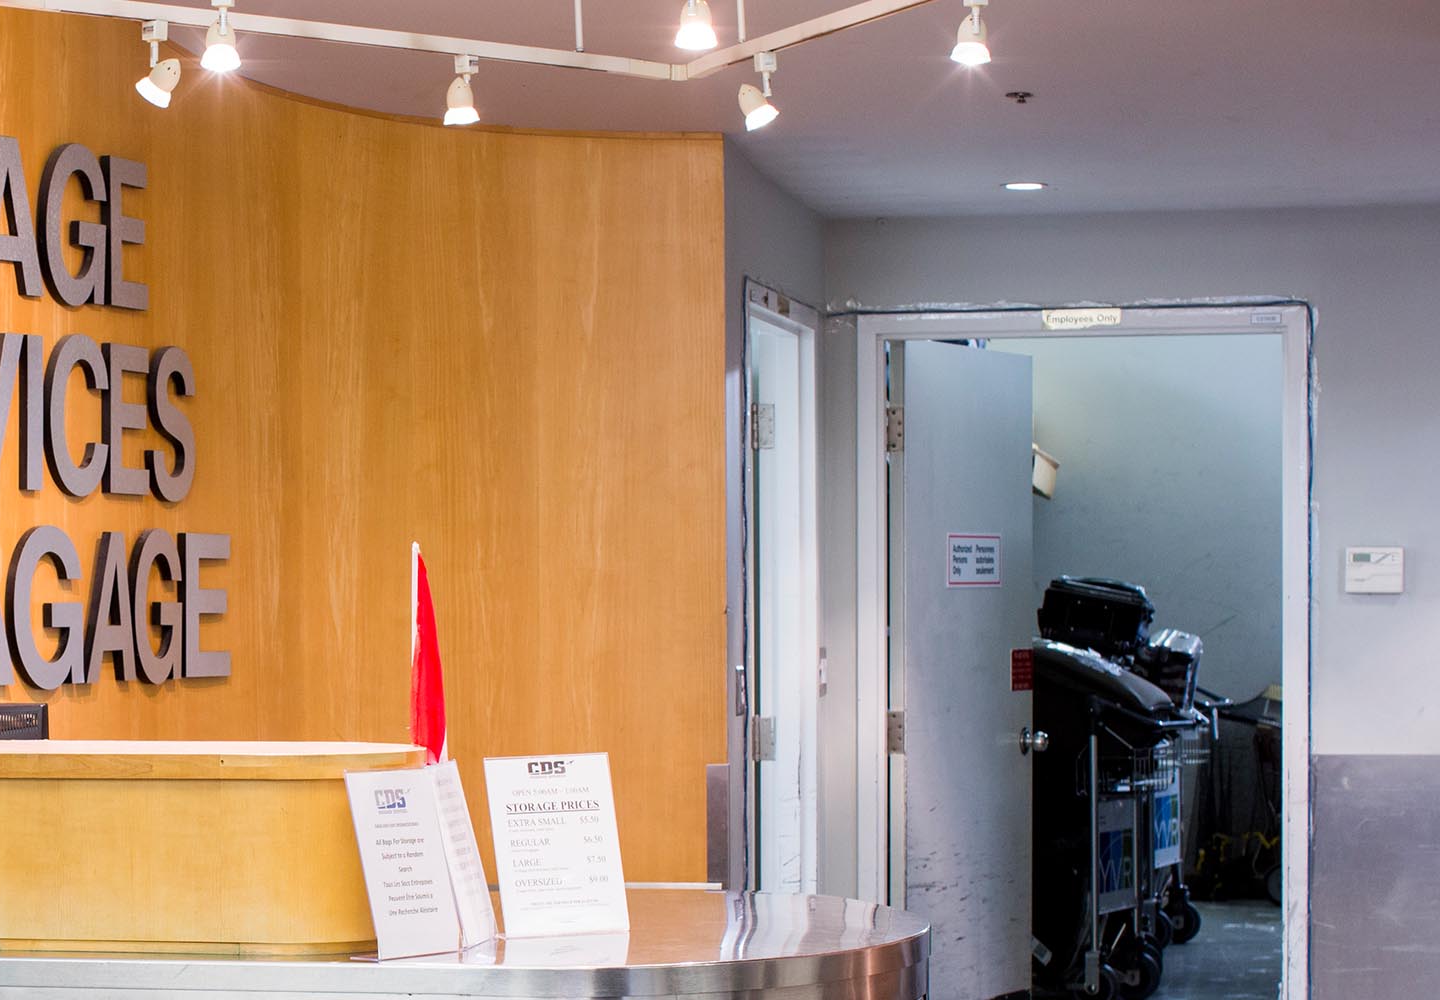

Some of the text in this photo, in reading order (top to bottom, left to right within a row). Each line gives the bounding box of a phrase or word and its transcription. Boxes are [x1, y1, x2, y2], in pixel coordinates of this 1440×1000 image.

[1046, 313, 1118, 324] Employees Only
[953, 544, 973, 553] Authorized
[975, 544, 995, 553] Personnes
[953, 555, 968, 564] Persons
[953, 566, 962, 577] Only
[527, 761, 566, 775] CDS
[374, 789, 406, 810] CDS
[505, 799, 600, 813] STORAGE PRICES
[507, 817, 537, 828] EXTRA
[538, 815, 567, 826] SMALL
[1154, 817, 1178, 849] YVR
[510, 838, 551, 848] REGULAR
[512, 858, 542, 868] LARGE
[398, 865, 413, 873] Search
[1098, 856, 1133, 894] YVR
[515, 878, 563, 888] OVERSIZED
